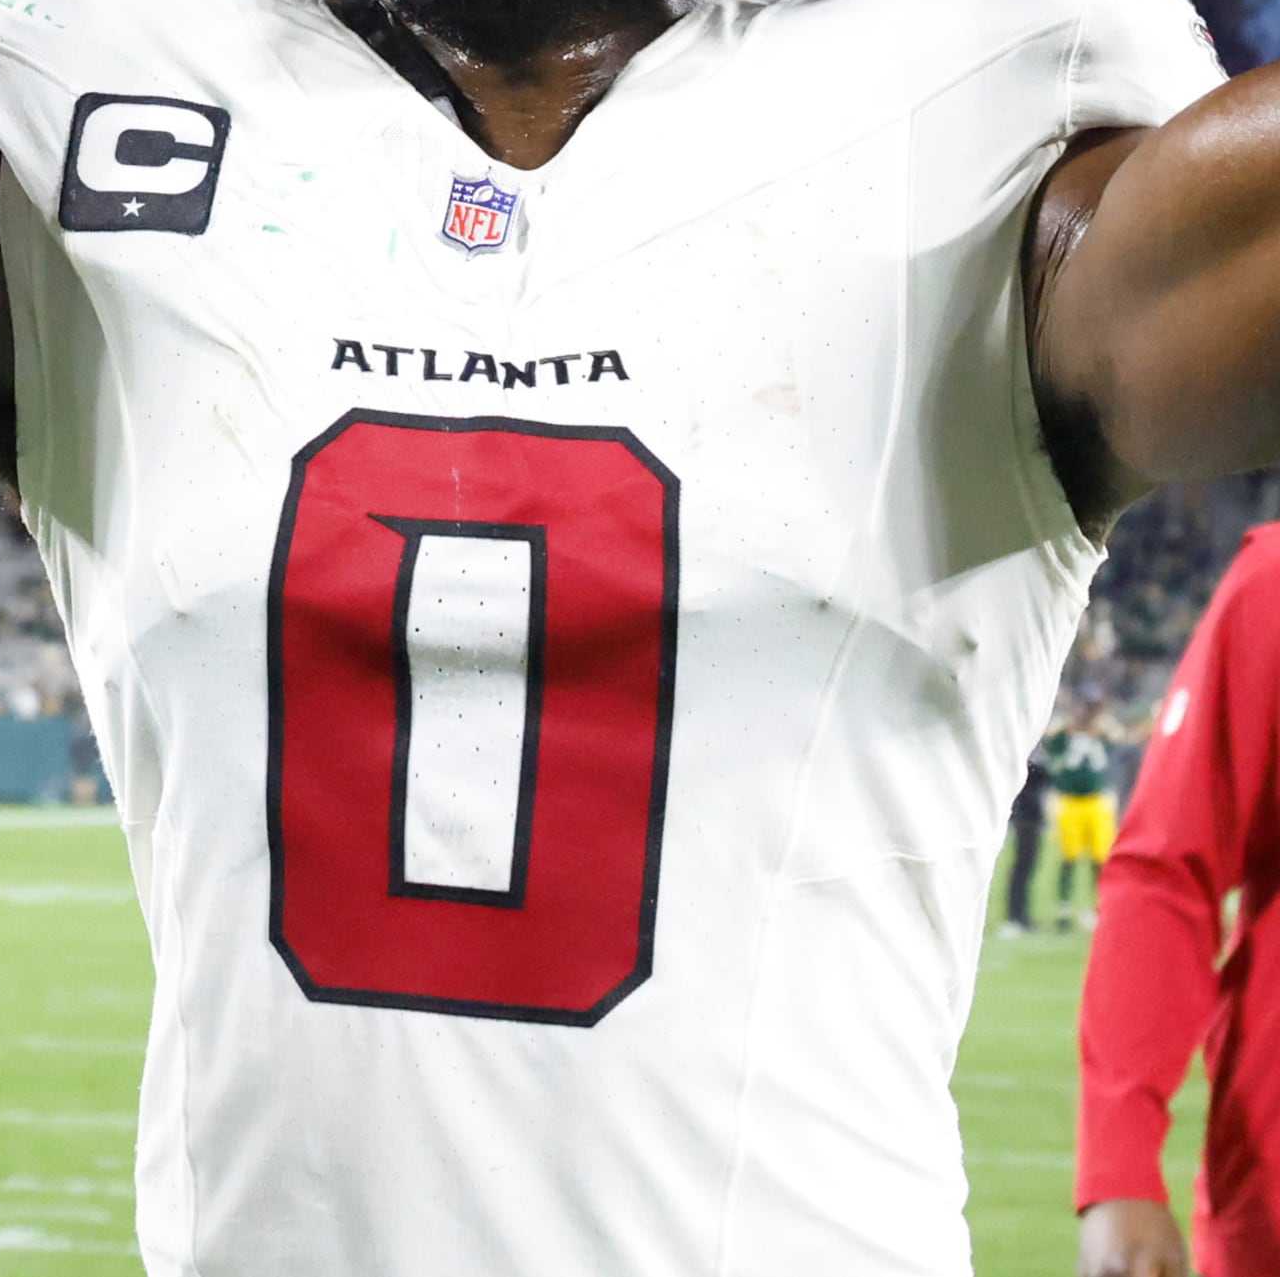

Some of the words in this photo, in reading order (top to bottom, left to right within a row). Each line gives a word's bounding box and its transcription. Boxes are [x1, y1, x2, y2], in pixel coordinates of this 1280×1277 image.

[77, 102, 216, 195] C
[448, 203, 501, 242] NFL
[331, 337, 631, 390] ATLANTA
[267, 407, 681, 1028] 0
